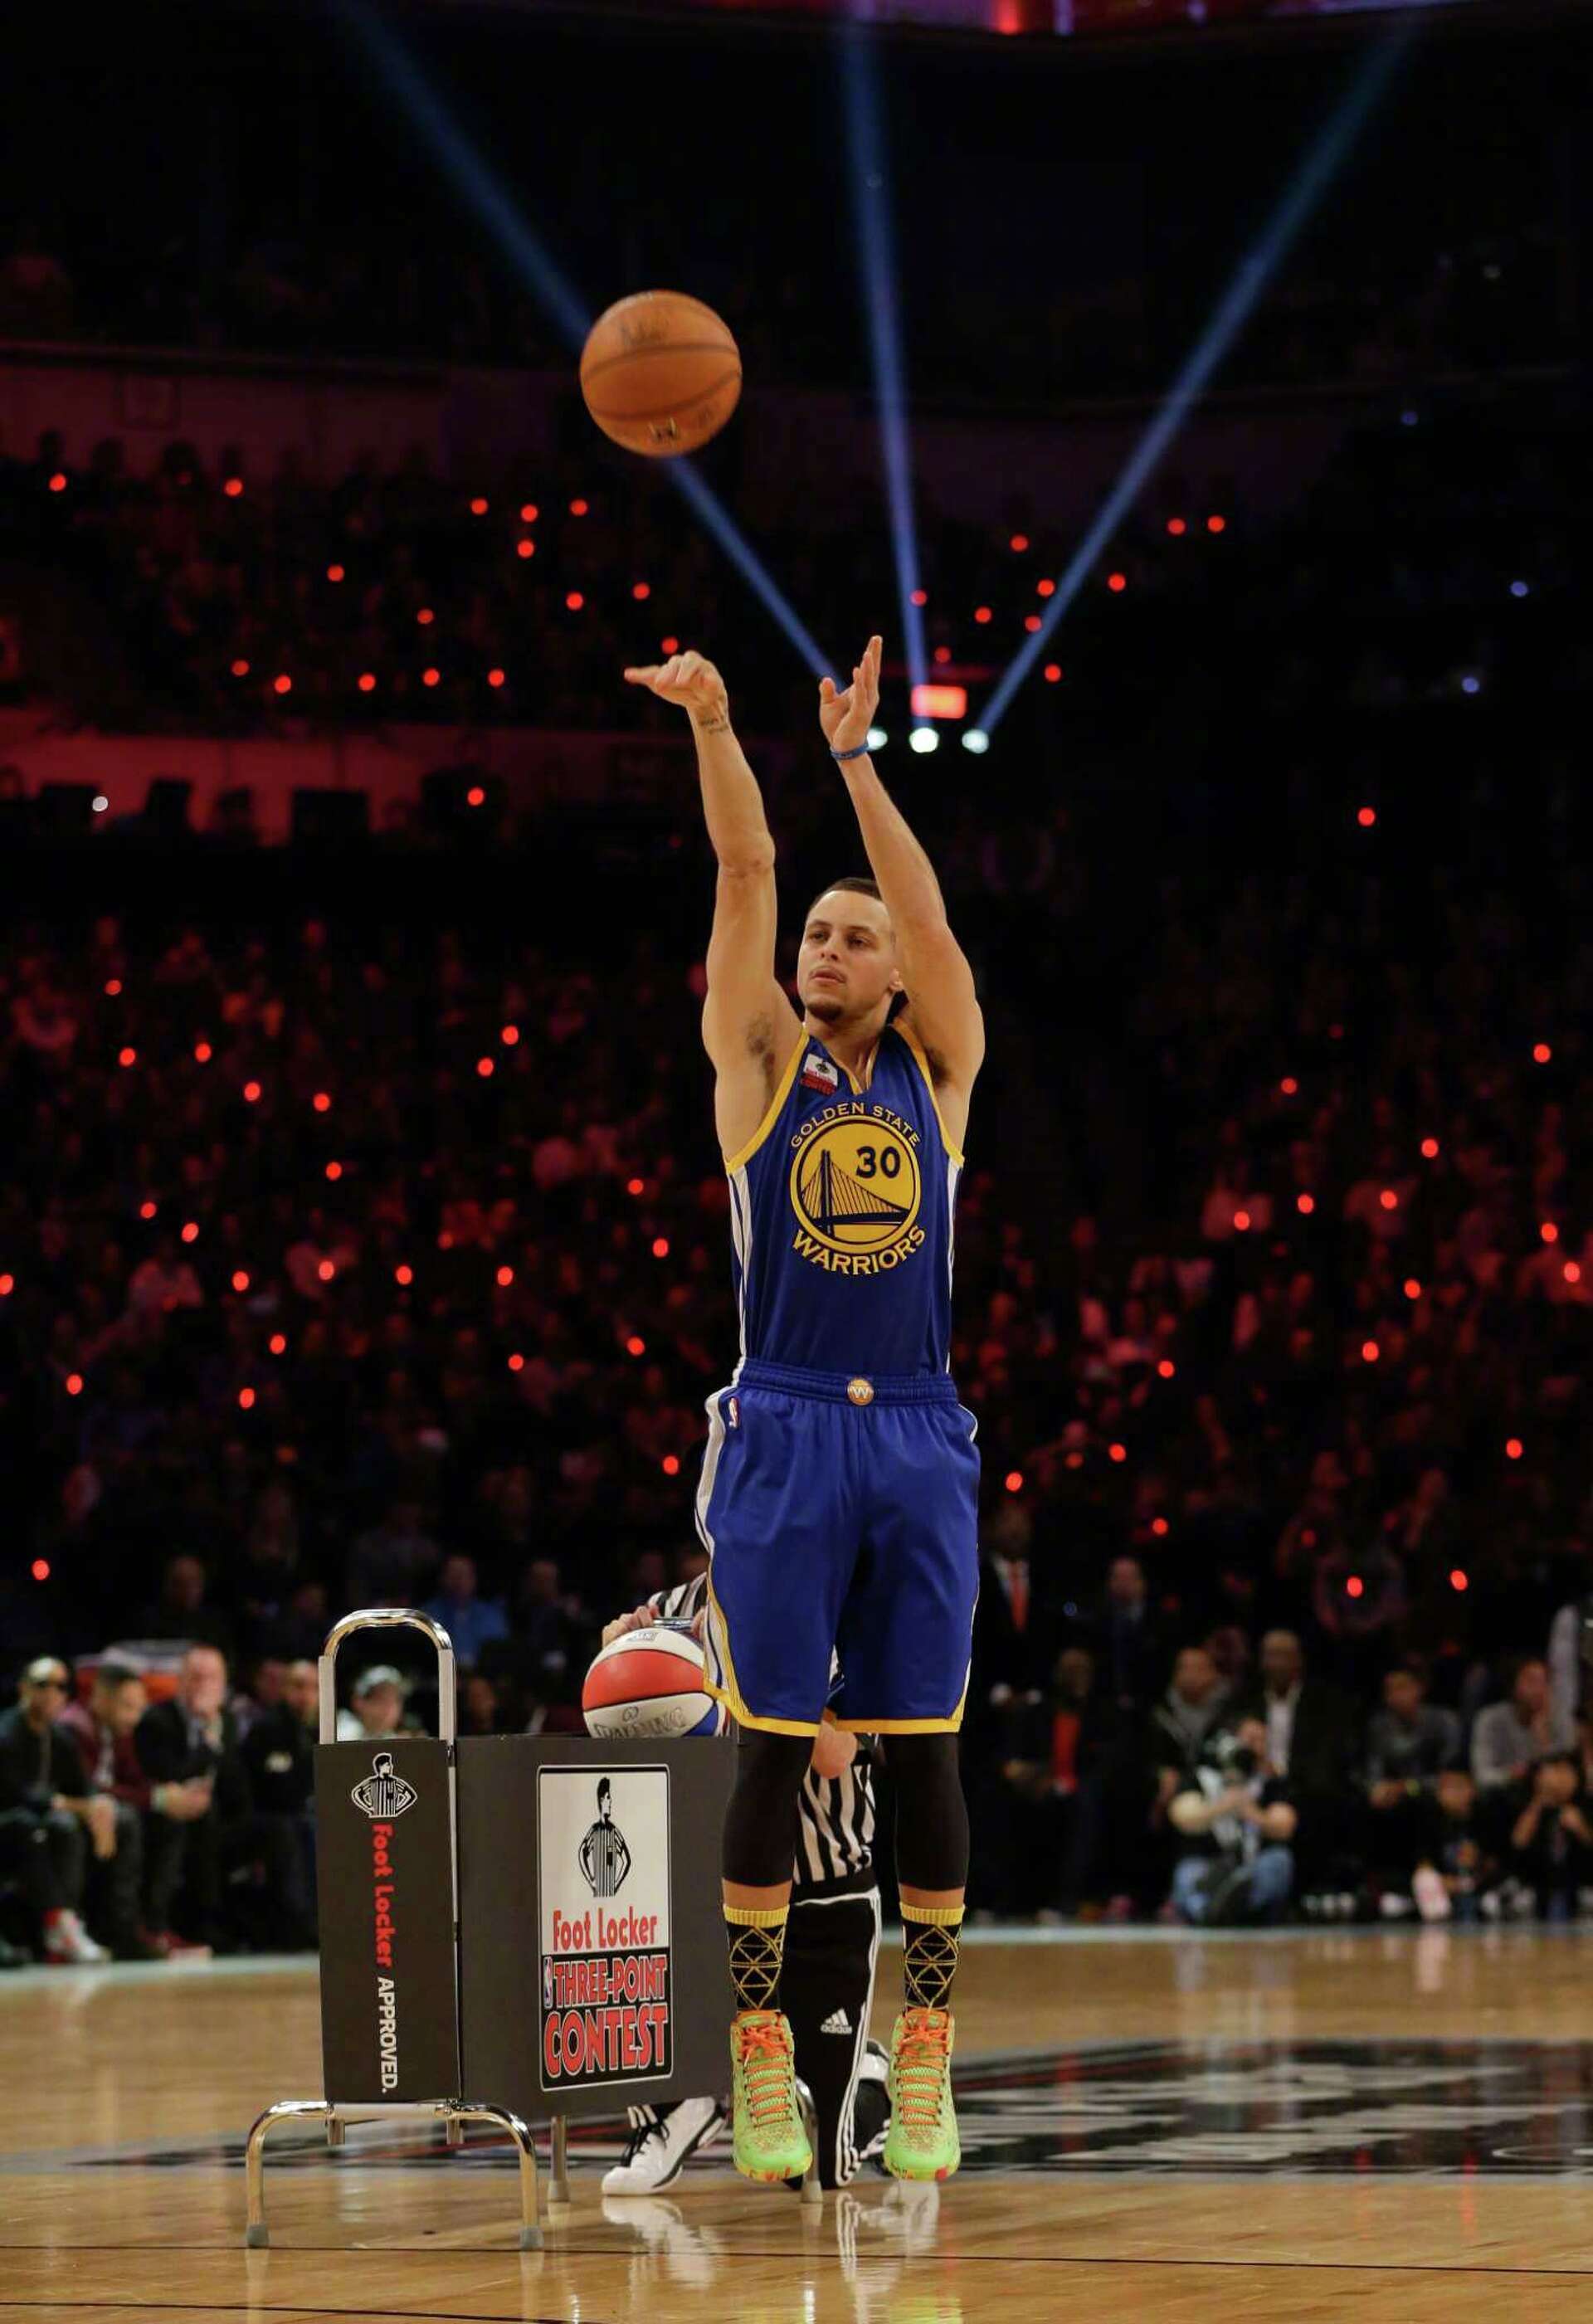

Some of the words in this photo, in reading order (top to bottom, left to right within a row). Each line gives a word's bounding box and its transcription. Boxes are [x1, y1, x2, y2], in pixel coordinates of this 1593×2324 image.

[791, 1102, 865, 1148] GOLDEN
[872, 1105, 921, 1147] STATE
[856, 1146, 900, 1178] 30
[792, 1225, 925, 1275] WARRIORS
[372, 1824, 394, 1878] Foot
[373, 1884, 396, 1968] Locker
[553, 1910, 592, 1951] Foot
[598, 1906, 657, 1948] Locker
[553, 1954, 668, 2009] THREE-POINT
[378, 1976, 398, 2093] APPROVED.
[544, 2002, 668, 2078] CONTEST
